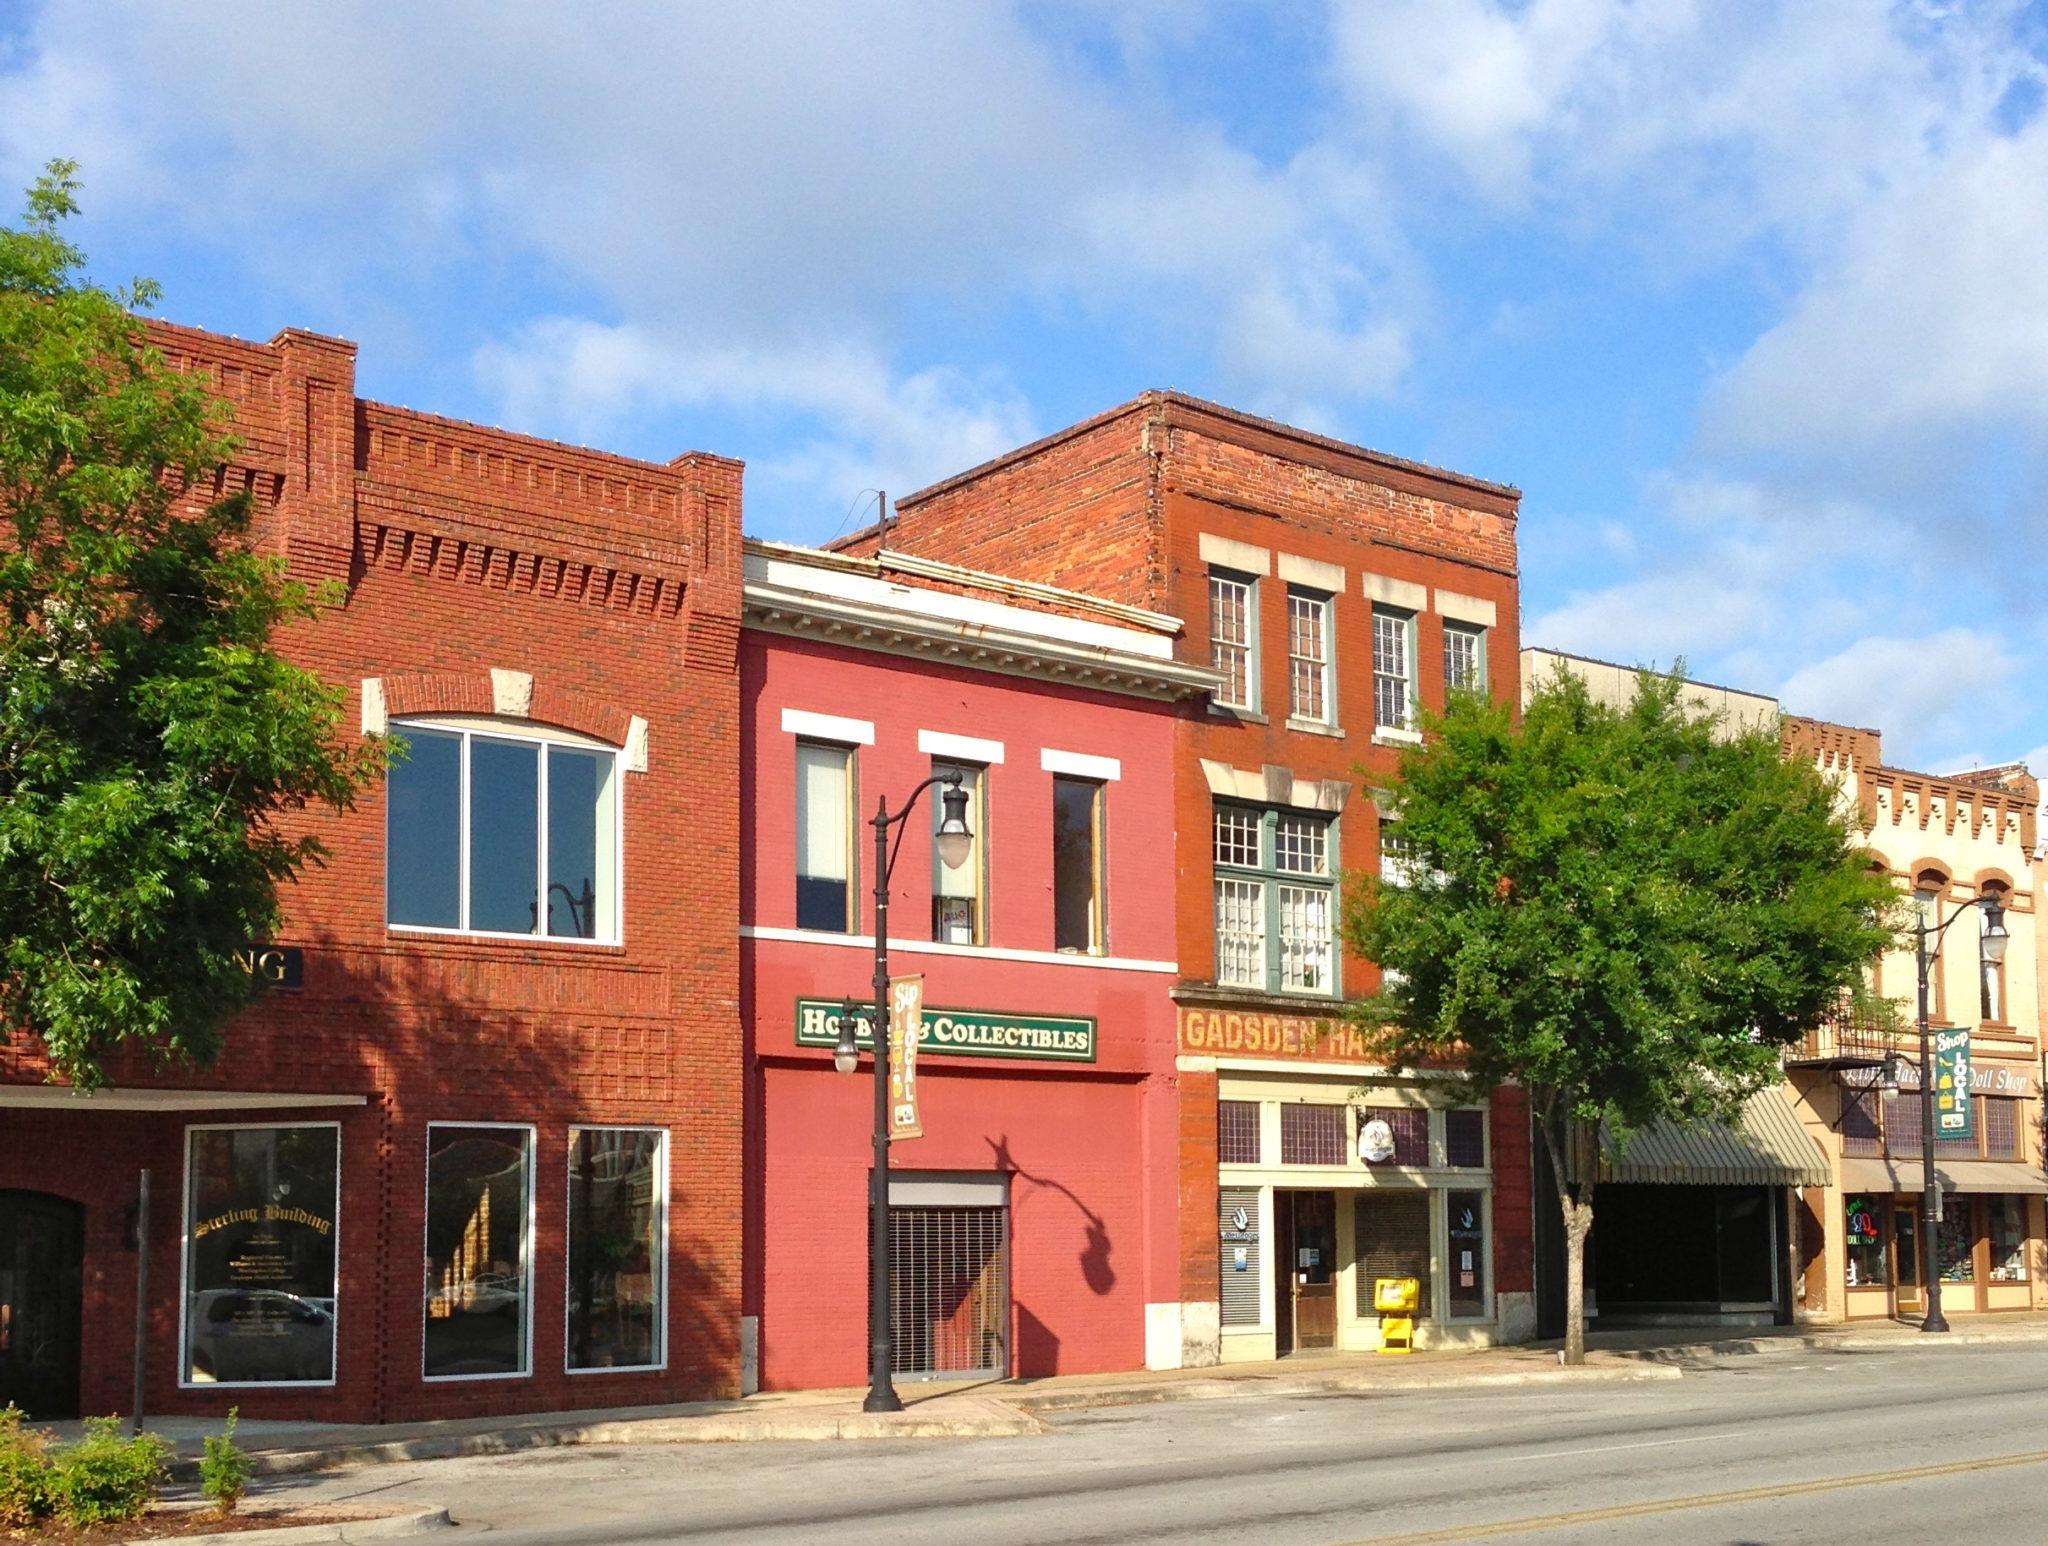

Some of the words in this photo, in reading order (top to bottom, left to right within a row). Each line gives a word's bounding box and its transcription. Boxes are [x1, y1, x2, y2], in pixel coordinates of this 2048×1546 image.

[894, 982, 918, 1014] Sip
[934, 1017, 1088, 1050] COLLECTIBLES
[1186, 1012, 1317, 1055] GADSDEN
[1936, 1031, 1969, 1052] Shop
[904, 1012, 916, 1102] LOCAL
[1953, 1051, 1968, 1112] LOCAL
[1996, 1068, 2028, 1094] Shop
[193, 1207, 258, 1239] Sterling
[264, 1203, 333, 1236] Building
